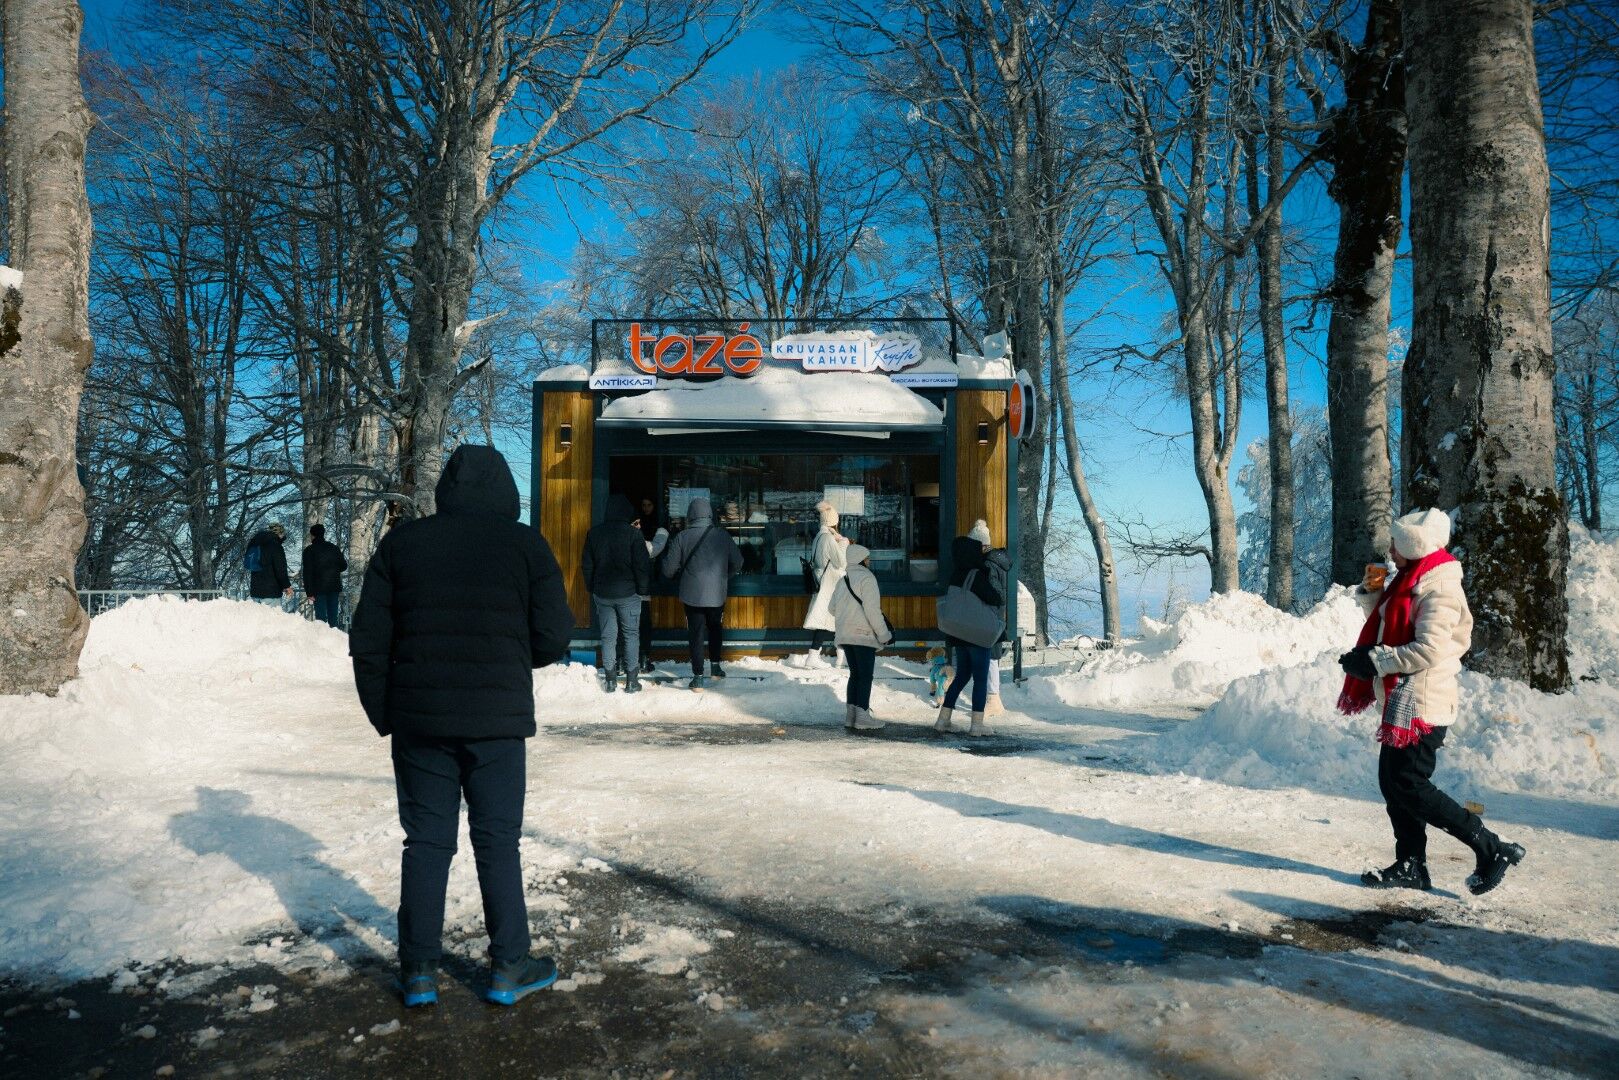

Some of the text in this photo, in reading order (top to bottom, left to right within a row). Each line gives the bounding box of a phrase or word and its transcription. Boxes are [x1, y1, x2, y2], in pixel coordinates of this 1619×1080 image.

[627, 322, 763, 374] tazé
[776, 344, 857, 354] KRUVASAN
[807, 356, 857, 365] KAHVE
